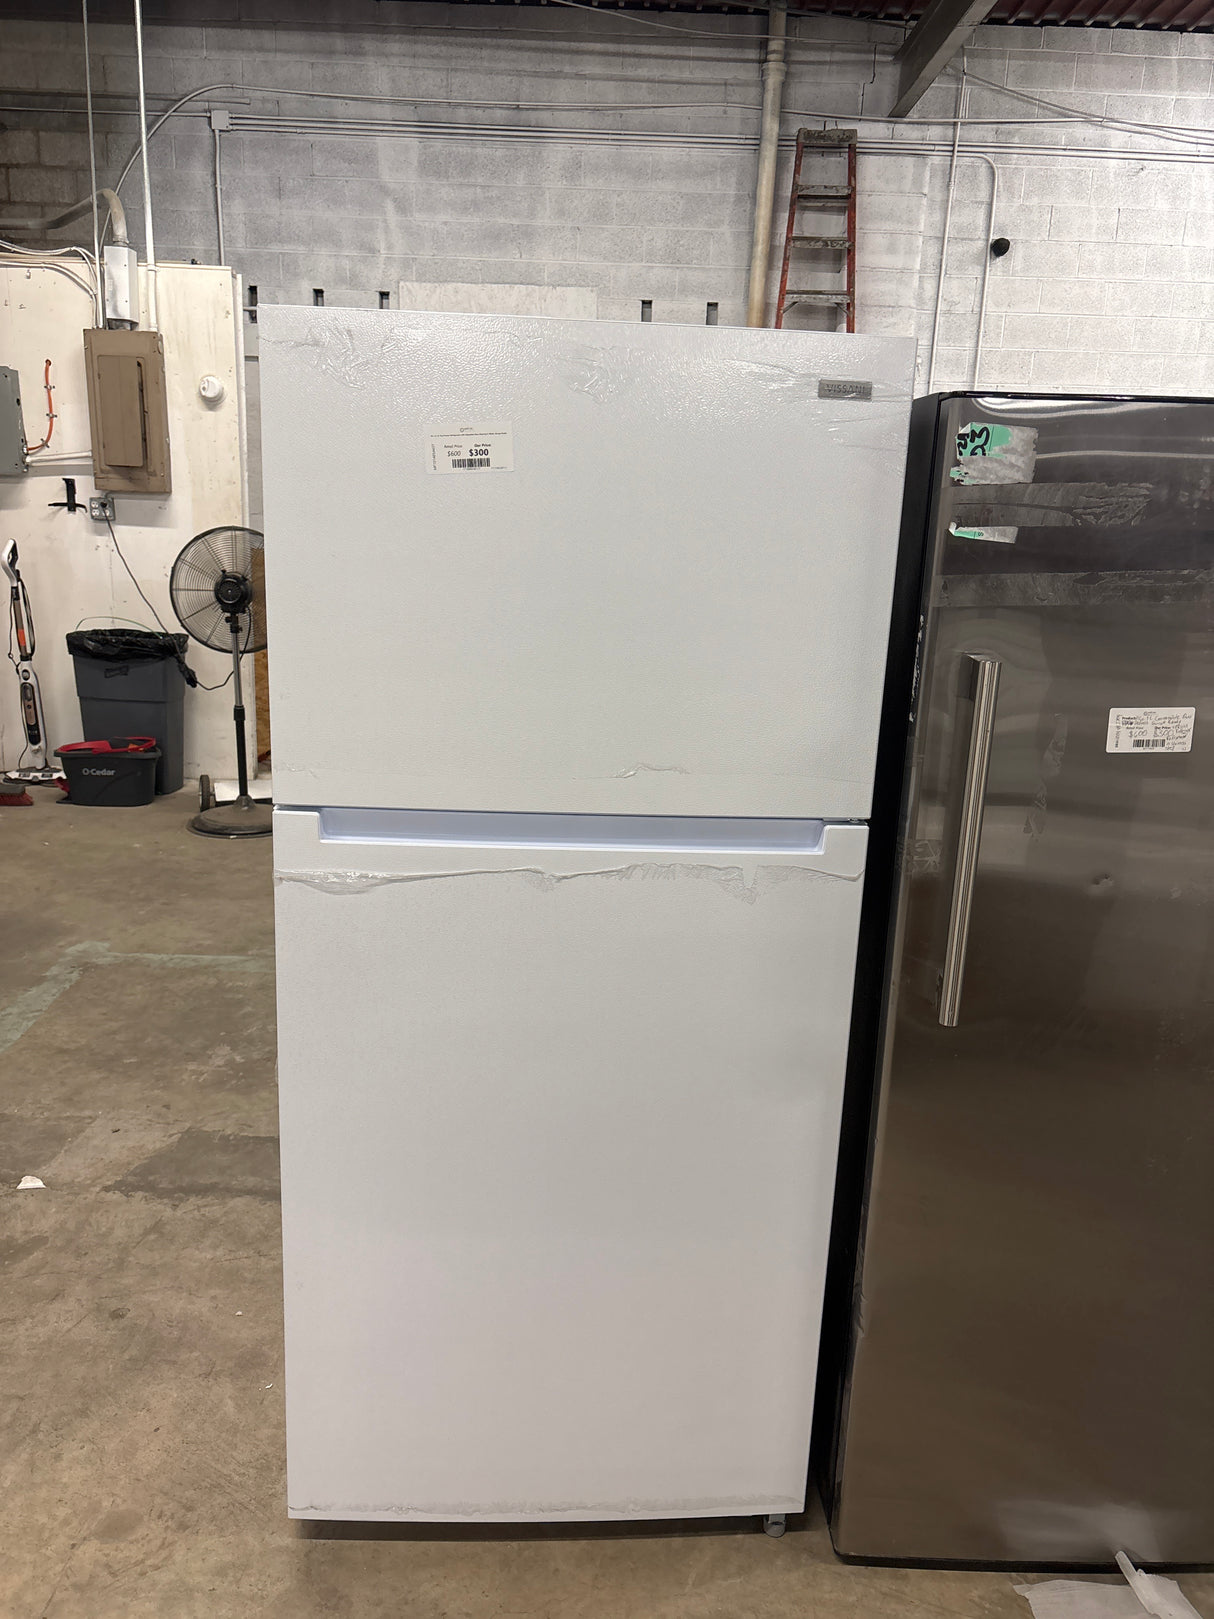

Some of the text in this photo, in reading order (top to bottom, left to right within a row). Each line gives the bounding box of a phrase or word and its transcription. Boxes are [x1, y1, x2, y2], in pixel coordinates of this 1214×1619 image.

[825, 384, 865, 394] VISSANI
[447, 450, 462, 458] $600
[468, 448, 489, 457] $300
